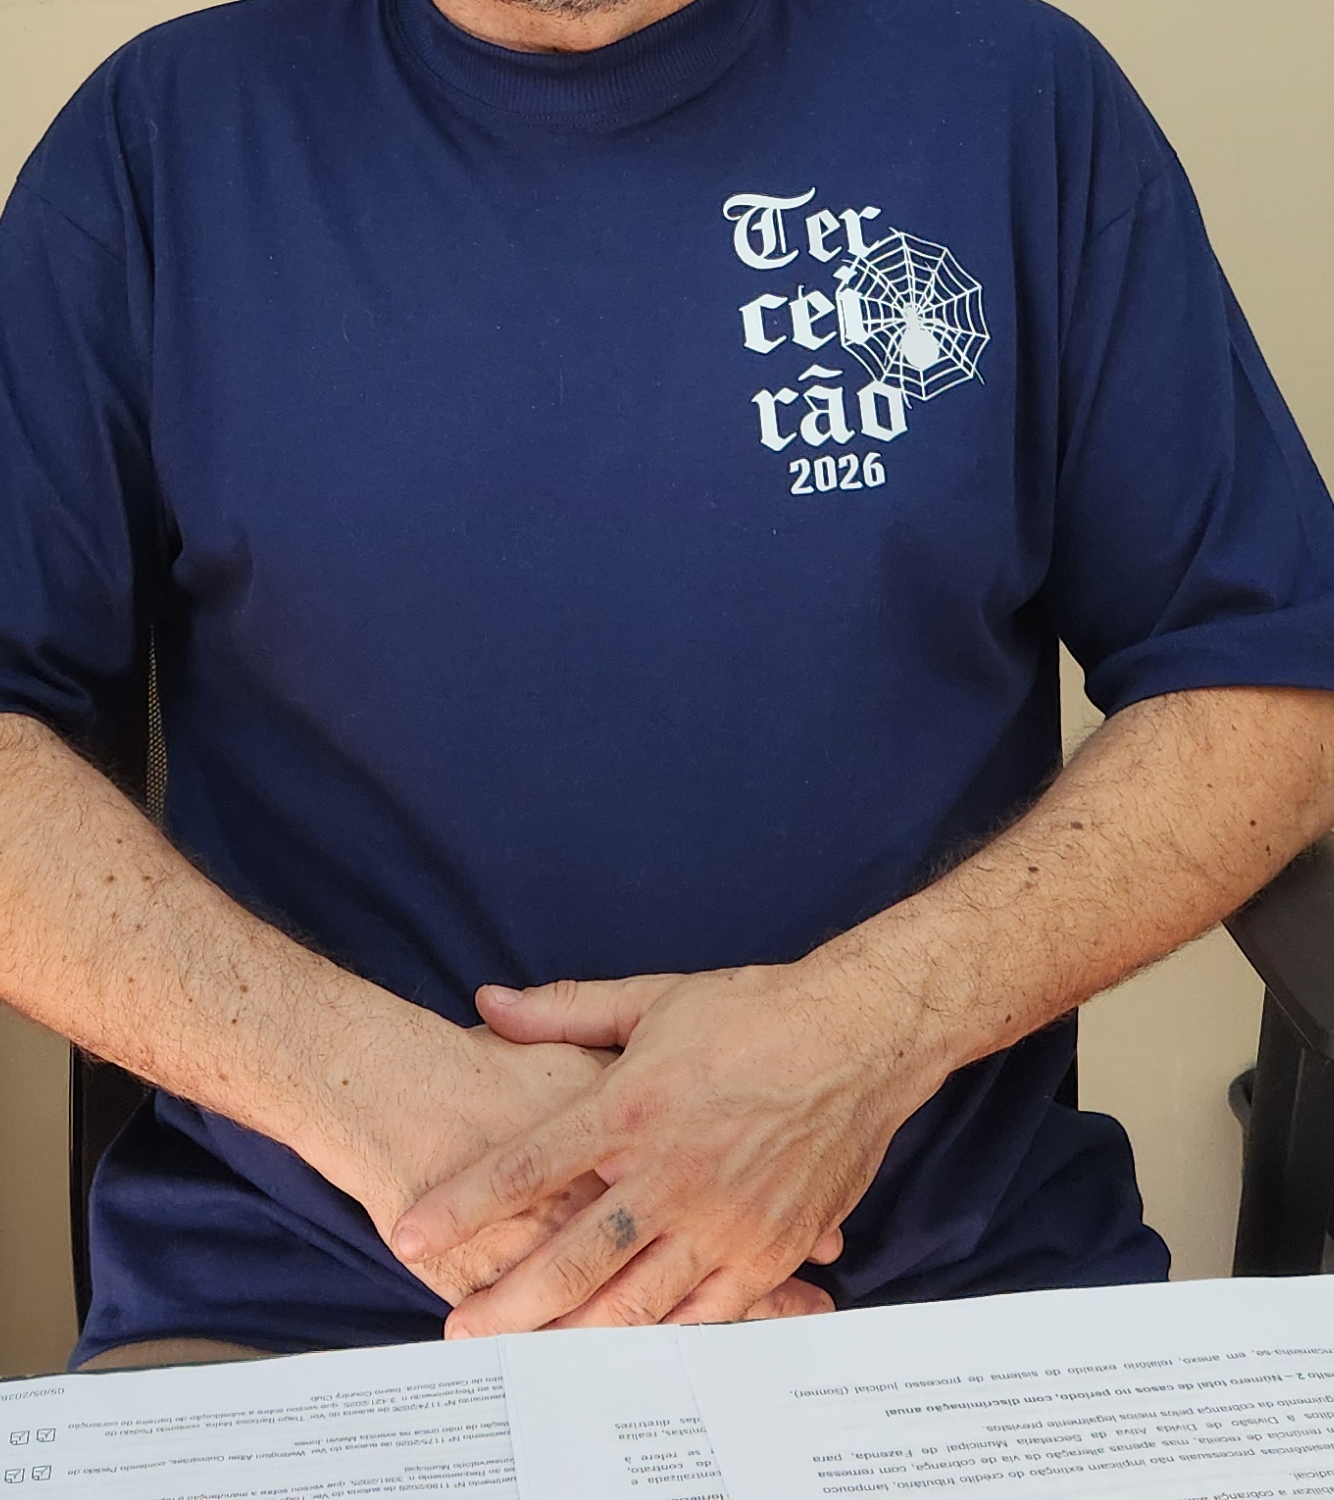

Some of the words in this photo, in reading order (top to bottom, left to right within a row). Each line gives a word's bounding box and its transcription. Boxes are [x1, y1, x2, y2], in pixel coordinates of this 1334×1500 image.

[723, 186, 882, 270] Ter
[751, 364, 909, 451] rão
[789, 451, 886, 495] 2026
